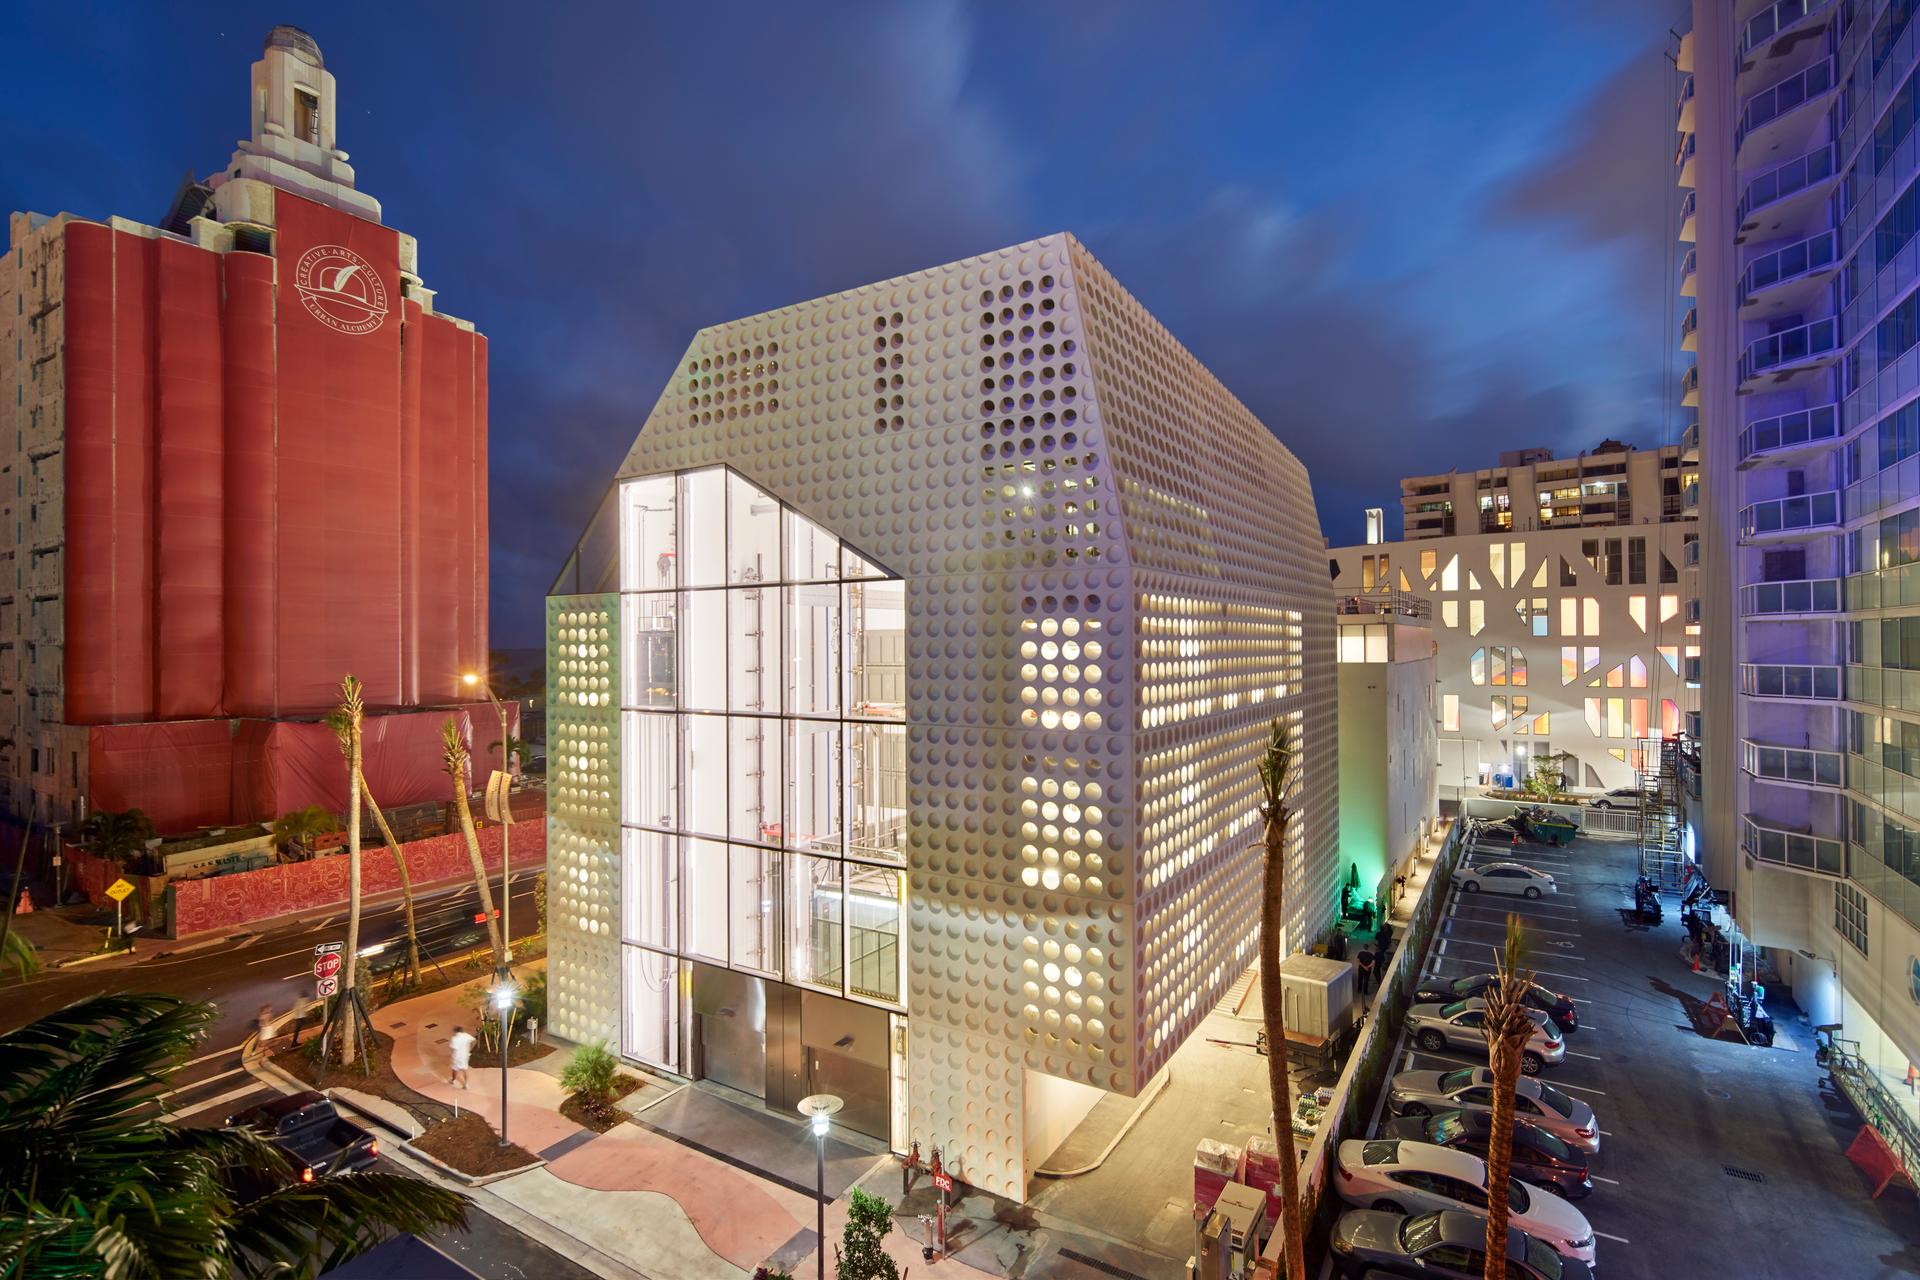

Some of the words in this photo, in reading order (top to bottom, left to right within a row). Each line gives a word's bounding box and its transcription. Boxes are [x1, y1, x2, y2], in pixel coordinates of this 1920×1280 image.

[300, 248, 328, 286] CREATIVE
[332, 248, 358, 263] ARTS
[361, 264, 385, 307] CULTURE
[309, 304, 338, 328] URBAN
[340, 319, 377, 332] ALCHEMY
[316, 958, 339, 973] STOP
[935, 1176, 950, 1189] FDC
